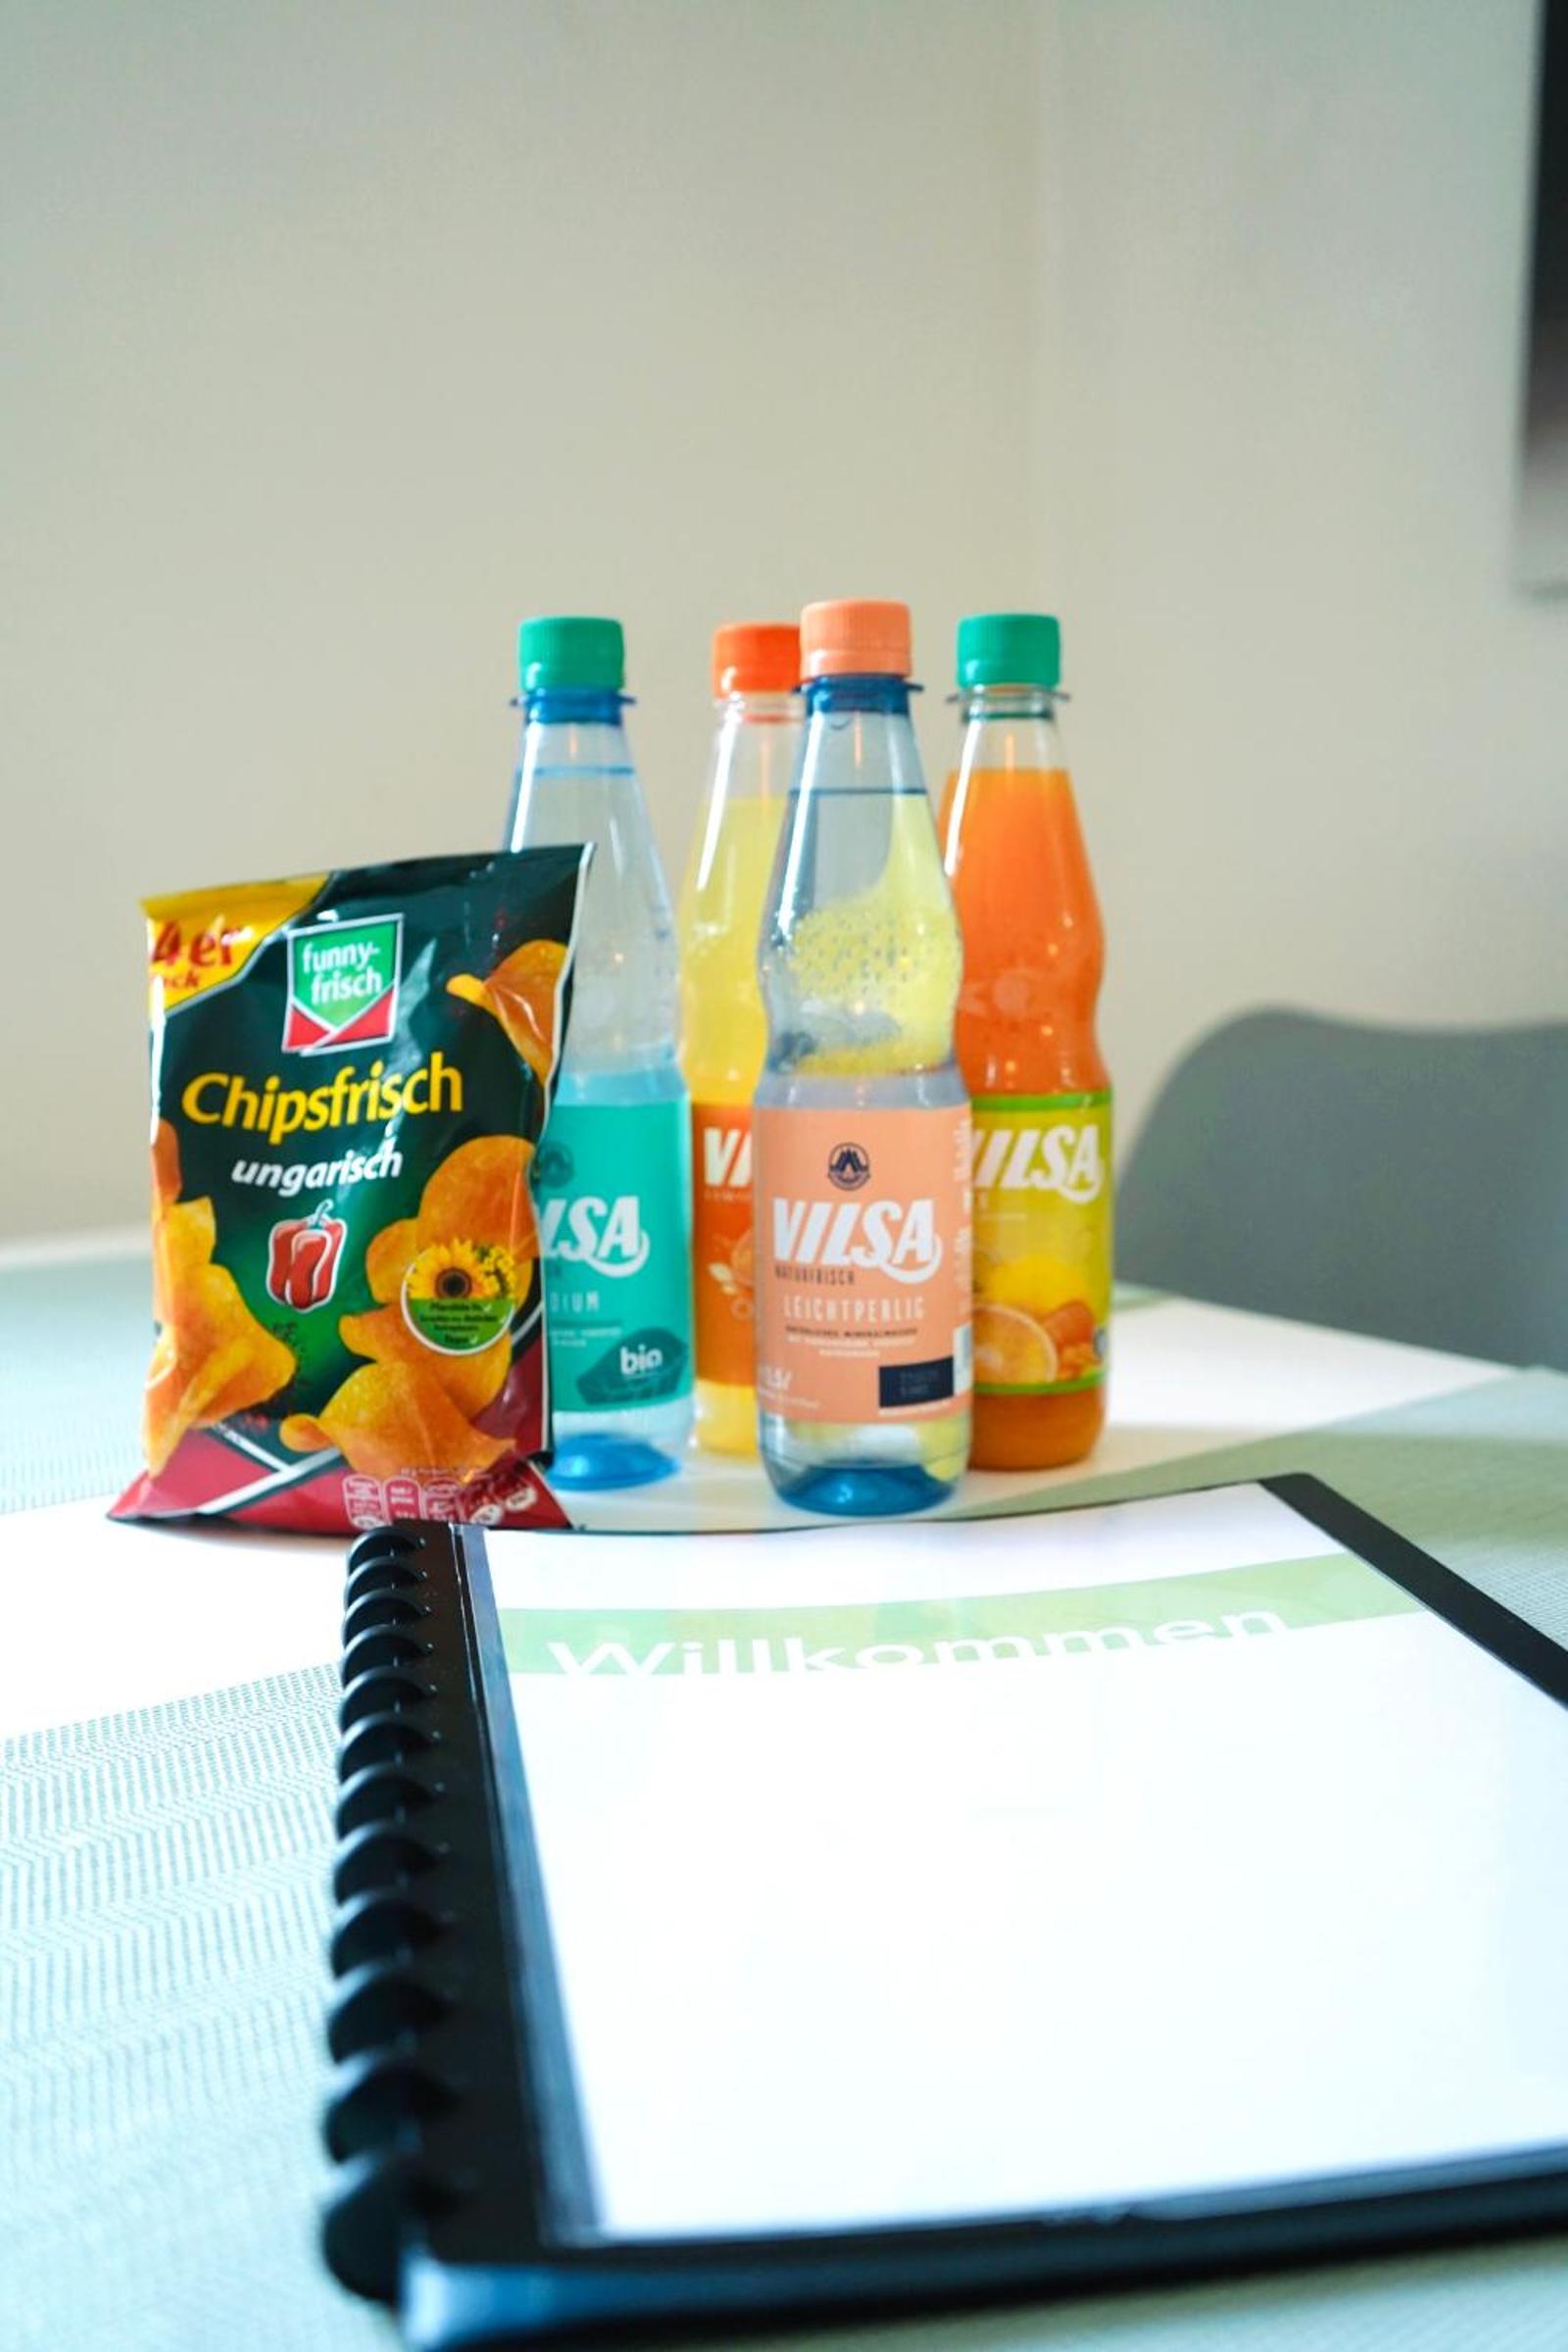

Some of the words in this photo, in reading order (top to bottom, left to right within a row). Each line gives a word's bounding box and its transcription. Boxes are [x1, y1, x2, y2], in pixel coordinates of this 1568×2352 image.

[152, 920, 246, 966] 4er
[302, 939, 380, 975] funny-
[310, 966, 383, 1005] frisch
[181, 1052, 464, 1145] Chipsfrisch
[231, 1146, 403, 1197] ungarisch
[540, 1195, 650, 1278] LSA
[771, 1197, 943, 1284] VILSA
[784, 1295, 925, 1323] LEICHTPERLIG
[620, 1344, 662, 1376] bio
[544, 1605, 1294, 1676] Willkommen
